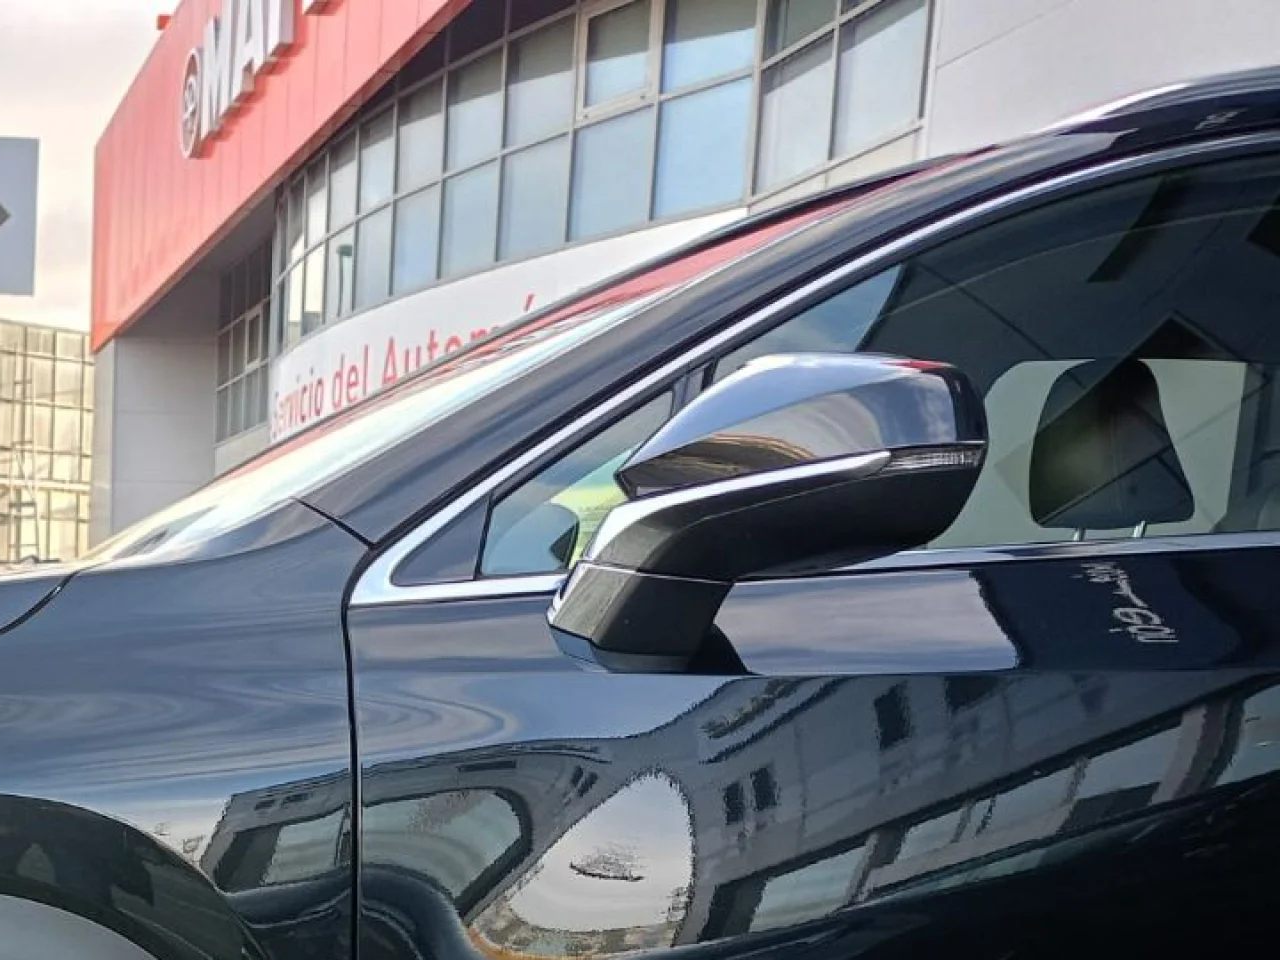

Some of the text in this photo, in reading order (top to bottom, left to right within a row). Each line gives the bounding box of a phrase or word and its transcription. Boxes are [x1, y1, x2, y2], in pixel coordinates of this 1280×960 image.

[199, 0, 322, 140] MA
[332, 344, 370, 410] del
[381, 293, 536, 386] Auto
